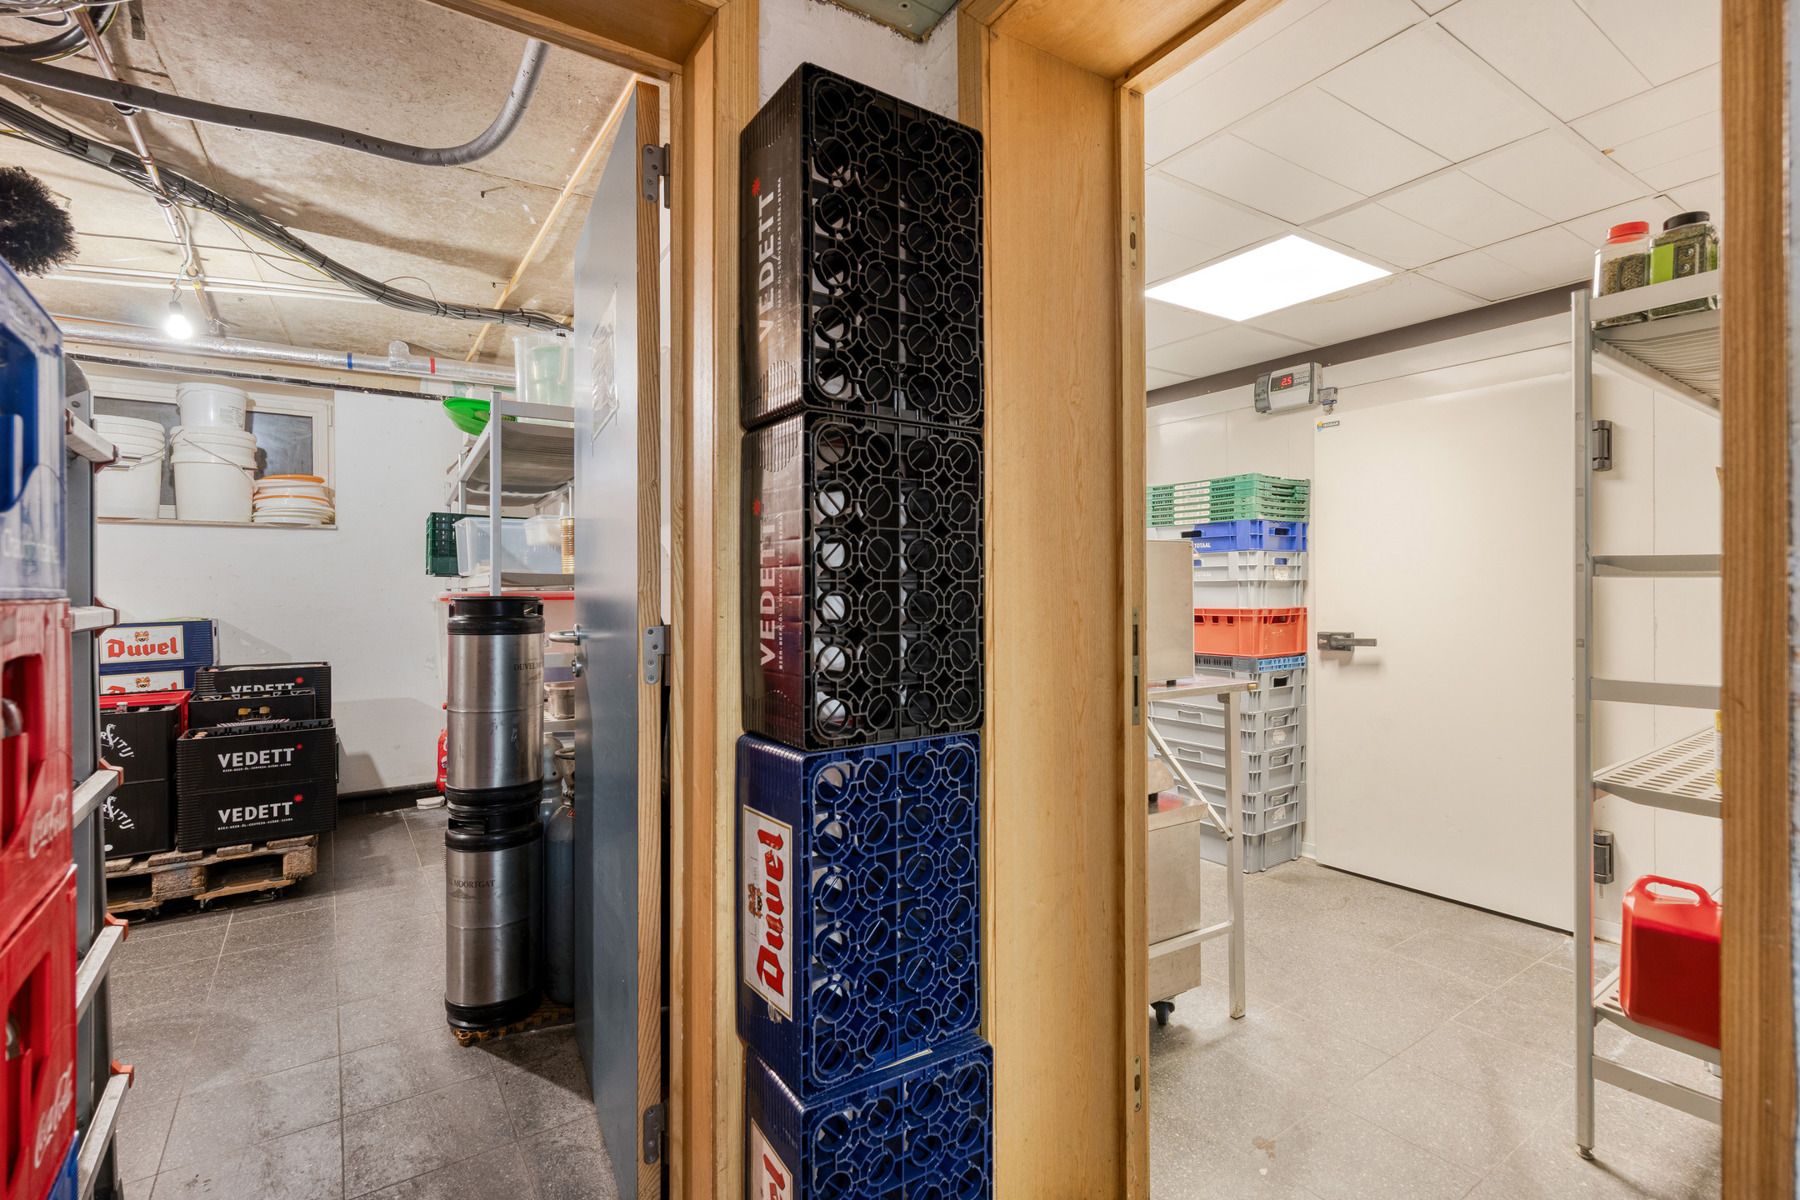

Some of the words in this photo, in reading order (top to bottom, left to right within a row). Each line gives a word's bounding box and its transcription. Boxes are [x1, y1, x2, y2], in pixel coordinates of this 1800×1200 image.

[759, 191, 774, 343] VEDETT
[760, 517, 776, 666] VEDETT
[106, 637, 178, 658] Duvel
[217, 748, 295, 769] VEDETT
[218, 802, 293, 824] VEDETT
[757, 829, 784, 996] Duvel
